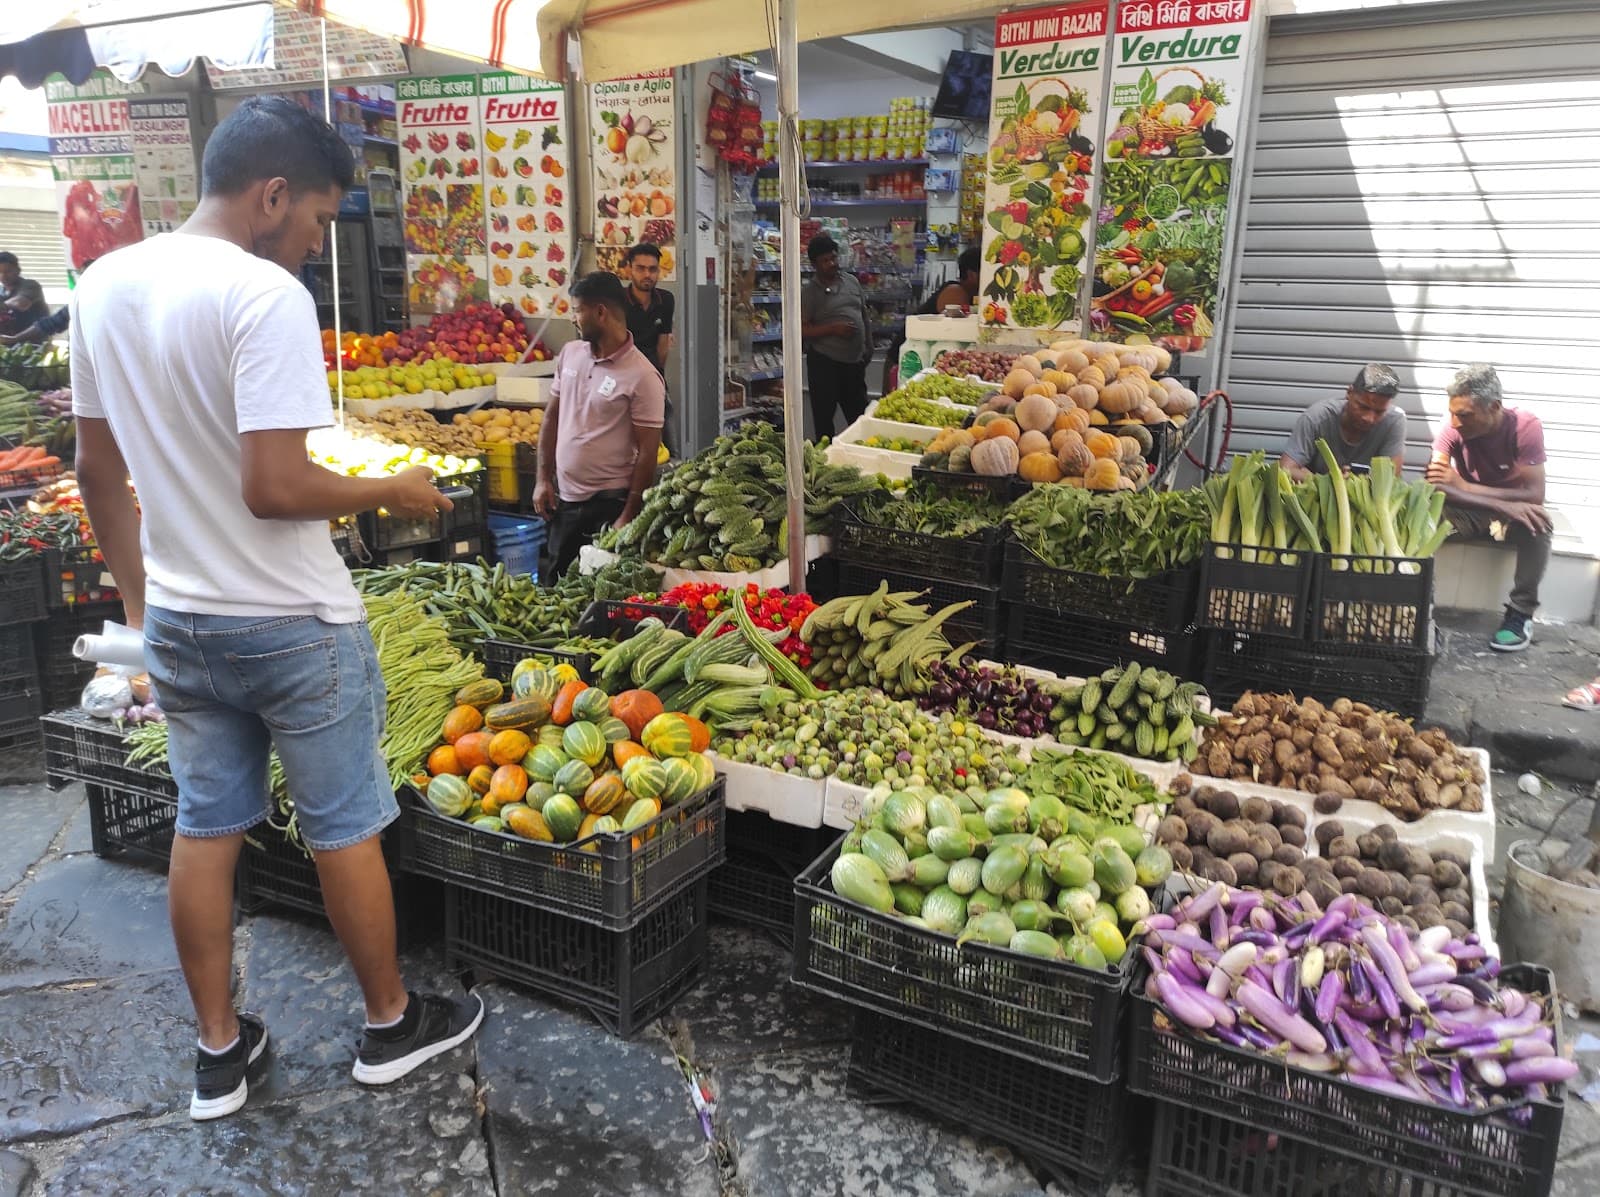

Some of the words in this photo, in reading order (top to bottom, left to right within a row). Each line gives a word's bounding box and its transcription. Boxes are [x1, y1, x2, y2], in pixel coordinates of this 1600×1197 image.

[1157, 0, 1192, 25] মিনি
[1195, 0, 1246, 22] বাজার
[1000, 21, 1031, 43] BITHI
[1033, 18, 1059, 39] MINI
[1062, 12, 1102, 36] BAZAR
[1121, 29, 1242, 62] Verdura
[1001, 42, 1100, 75] Verdura
[482, 76, 506, 93] BITHI
[508, 75, 529, 92] MINI
[594, 82, 630, 96] Cipolla
[633, 83, 640, 91] e
[643, 79, 672, 93] Aglio
[401, 102, 469, 123] Frutta
[485, 97, 558, 119] Frutta
[133, 120, 185, 131] CASALINGHI
[134, 133, 190, 144] PROFUMERIA
